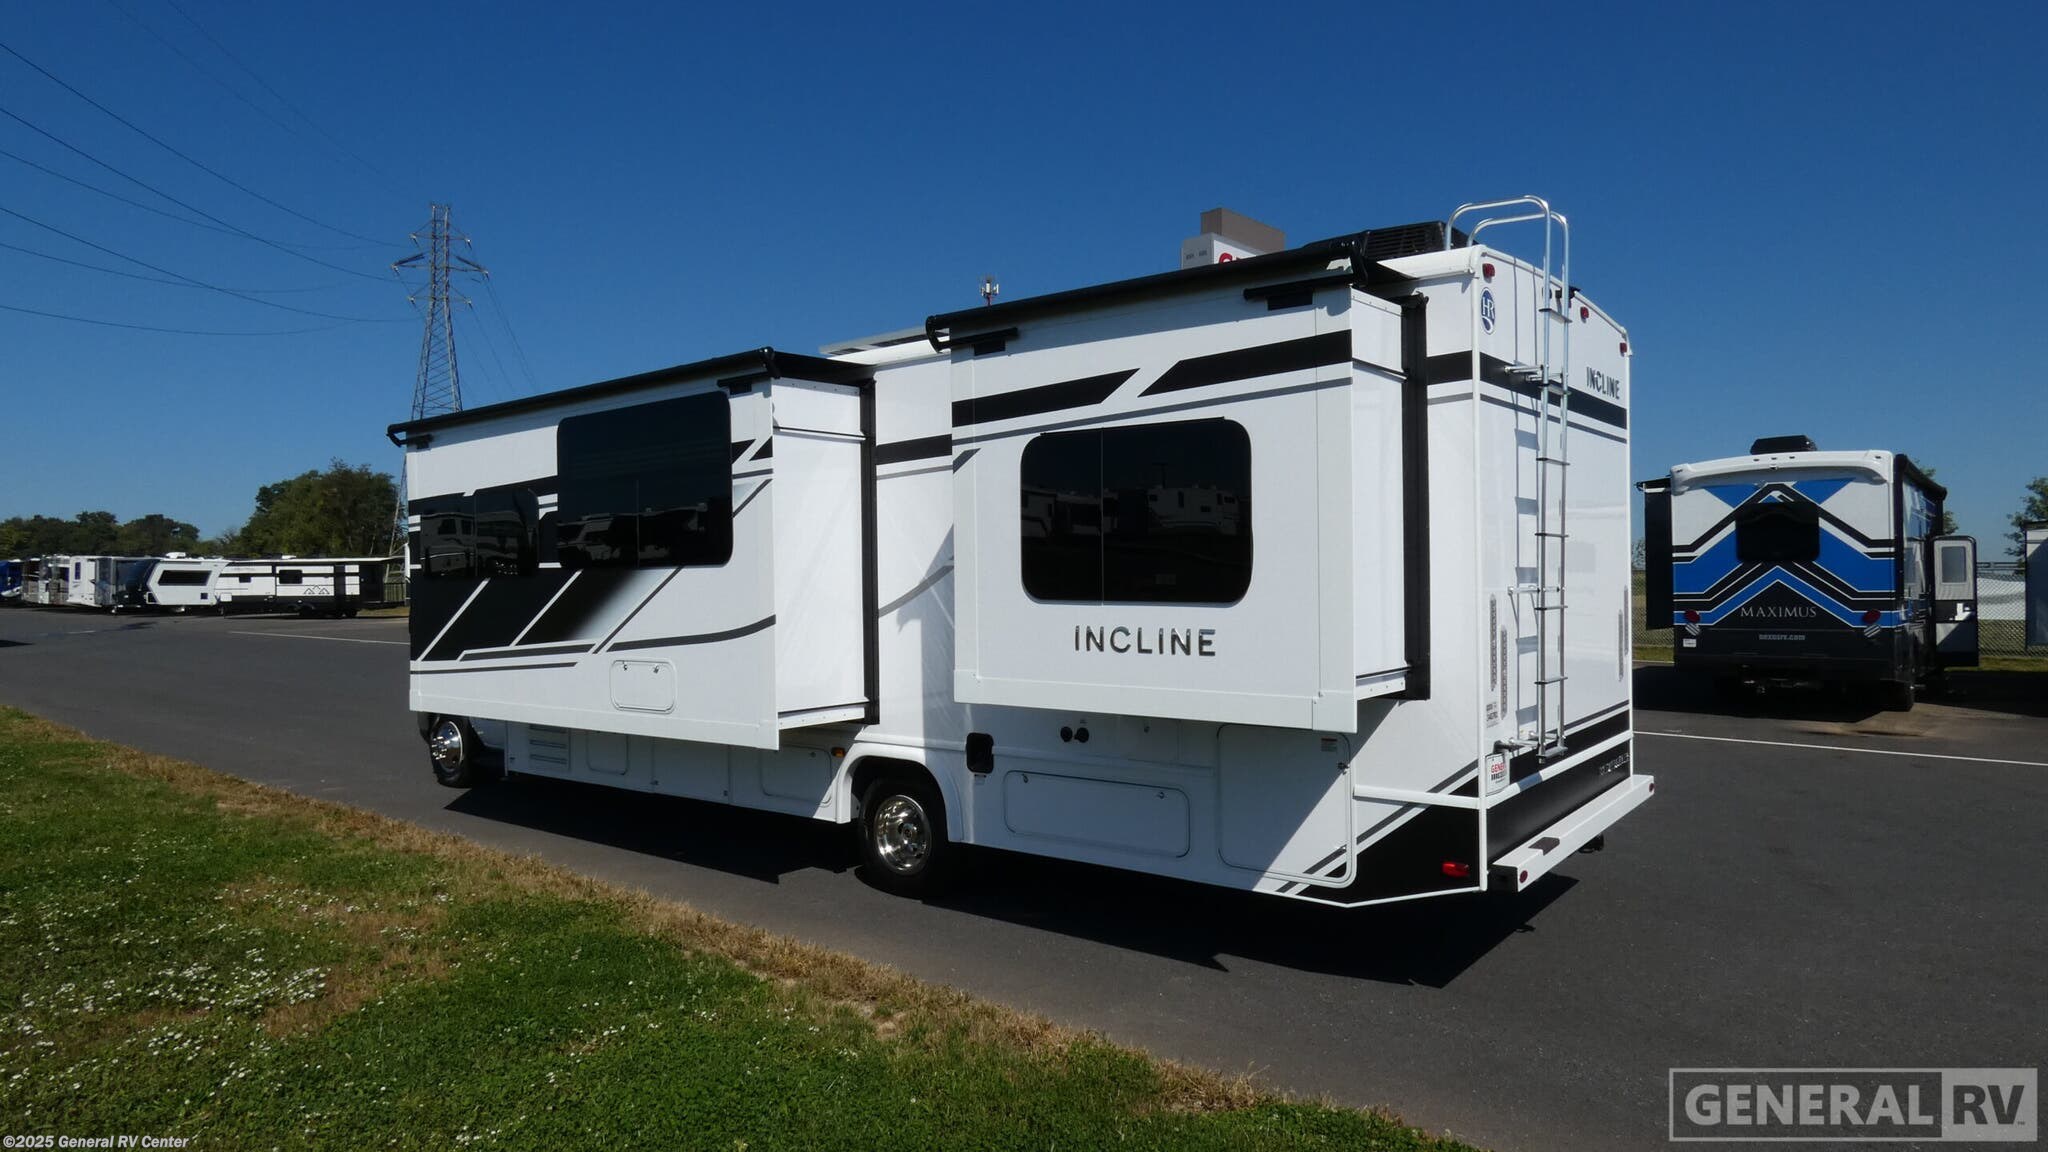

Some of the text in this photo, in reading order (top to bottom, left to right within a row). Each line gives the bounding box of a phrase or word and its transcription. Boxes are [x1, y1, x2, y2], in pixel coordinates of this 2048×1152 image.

[1586, 366, 1620, 400] INCLINE
[1740, 606, 1817, 618] MAXIMUS
[1074, 625, 1216, 657] INCLINE
